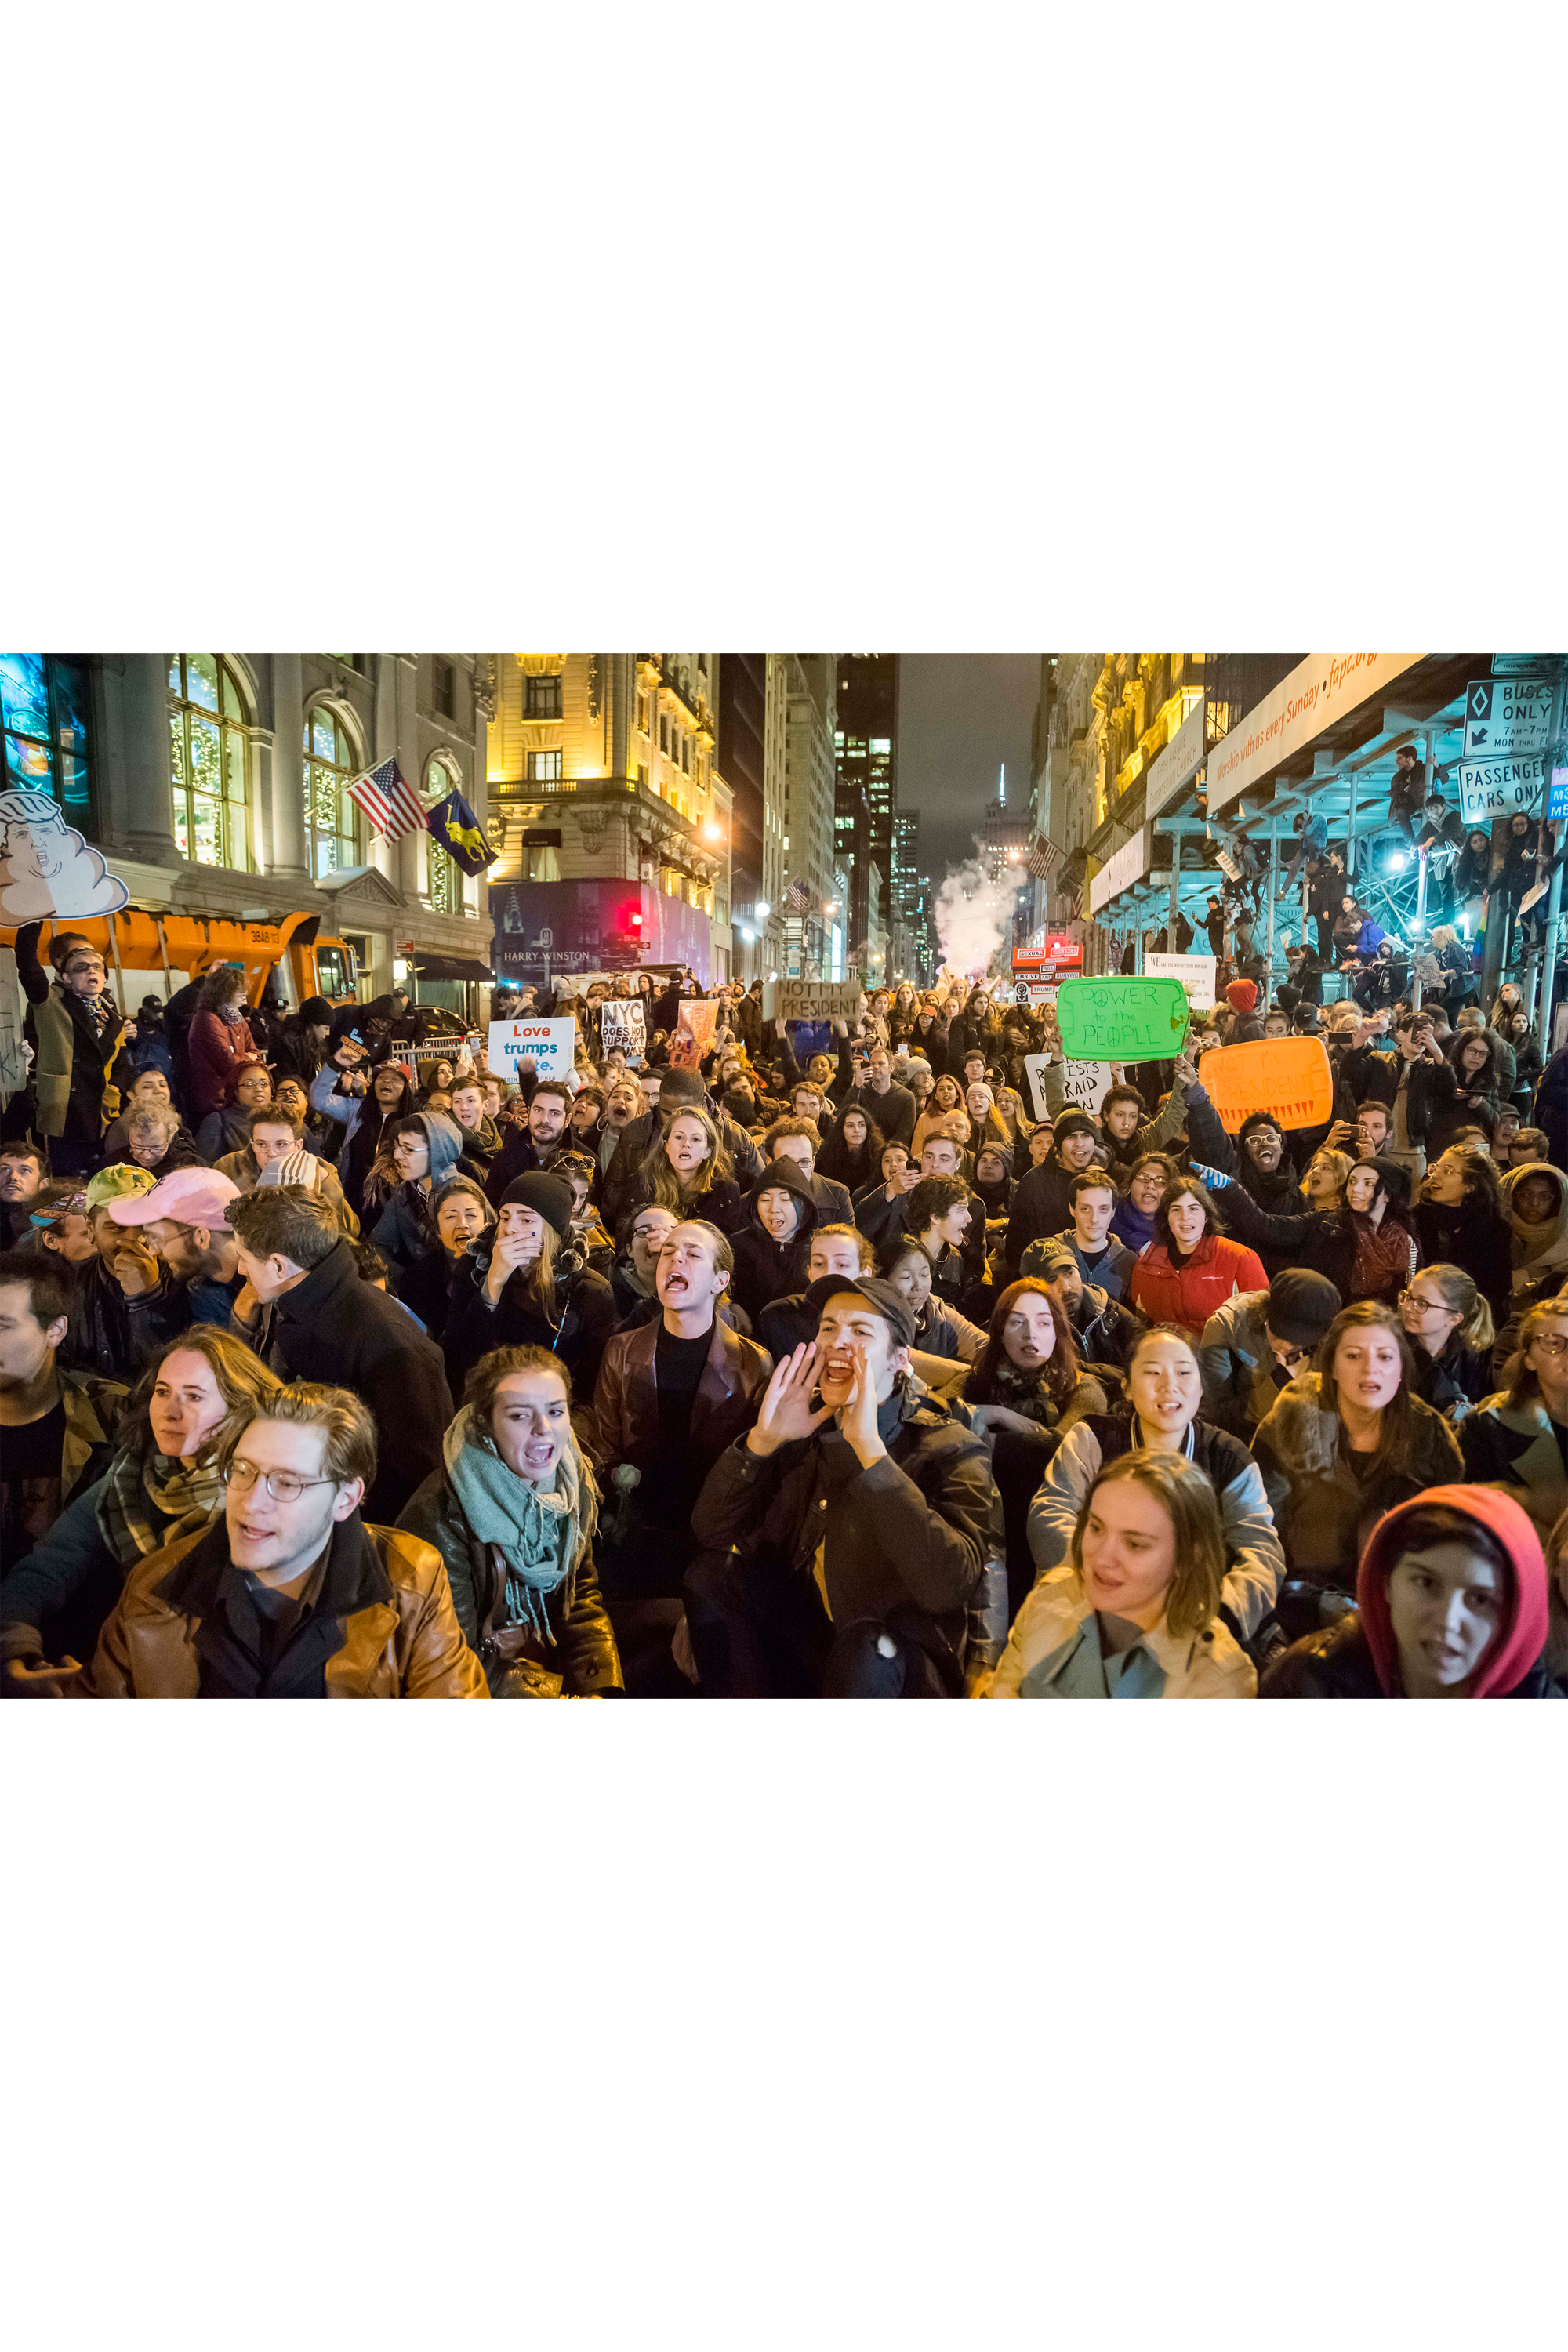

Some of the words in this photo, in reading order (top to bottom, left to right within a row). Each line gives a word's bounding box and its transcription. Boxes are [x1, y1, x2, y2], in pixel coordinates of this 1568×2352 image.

[1503, 682, 1553, 701] BUSES
[1502, 704, 1552, 720] ONLY
[1218, 750, 1240, 782] Worship
[1240, 734, 1254, 763] with
[1255, 731, 1265, 750] us
[1265, 712, 1286, 742] every
[1287, 682, 1320, 724] Sunday
[1494, 738, 1515, 747] MON
[1176, 742, 1198, 779] CHURCH
[1468, 790, 1504, 811] CARS
[504, 952, 539, 961] HARRY
[542, 951, 590, 961] WINSTON
[1150, 956, 1160, 967] WE
[779, 981, 817, 997] NOT
[819, 982, 846, 996] MY
[1081, 986, 1160, 1007] POWER
[603, 1002, 643, 1026] NYC
[782, 1000, 856, 1019] PRESIDENT
[1094, 1009, 1106, 1022] to
[1113, 1009, 1136, 1021] the
[514, 1025, 551, 1037] Love
[602, 1027, 630, 1036] DOES
[632, 1026, 645, 1036] NOT
[1083, 1024, 1161, 1047] PEOPLE
[503, 1042, 558, 1057] trumps
[1261, 1051, 1281, 1070] MY
[1035, 1062, 1100, 1083] RISTS
[1039, 1076, 1098, 1101] ARAID
[1218, 1073, 1310, 1104] PRESIDENT
